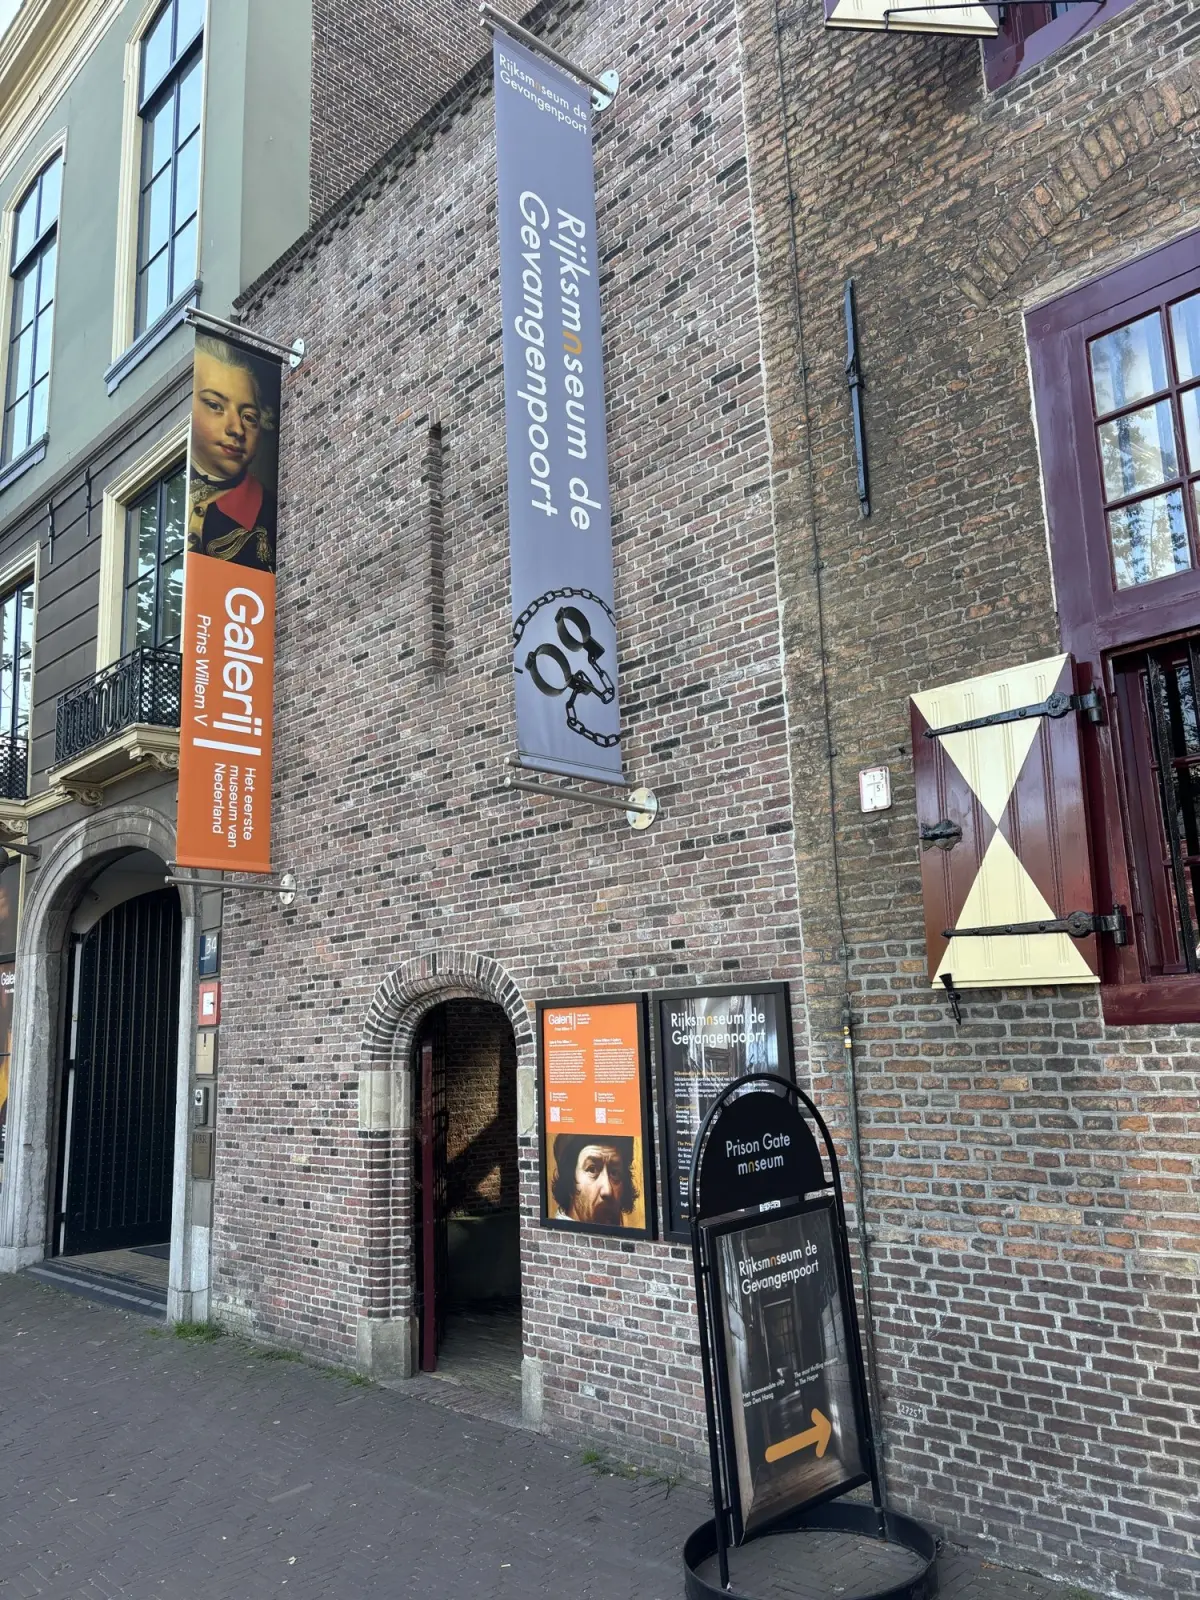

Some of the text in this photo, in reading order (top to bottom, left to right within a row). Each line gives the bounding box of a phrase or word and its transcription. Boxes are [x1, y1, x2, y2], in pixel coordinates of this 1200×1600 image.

[500, 70, 588, 135] Gevangenpoort
[573, 104, 587, 121] de
[514, 190, 559, 517] Gevangenpoort
[568, 476, 602, 531] de
[193, 614, 212, 727] Prins Willem V
[212, 587, 265, 737] Galerij
[212, 762, 226, 834] Nederland
[227, 765, 239, 848] museum van
[242, 767, 257, 841] Het eerste
[206, 936, 217, 955] 34
[671, 1028, 766, 1048] Gevangenpoort
[750, 1007, 766, 1024] de
[726, 1132, 791, 1158] Prison Gate
[805, 1239, 818, 1257] de
[741, 1259, 819, 1295] Gevangenpoort
